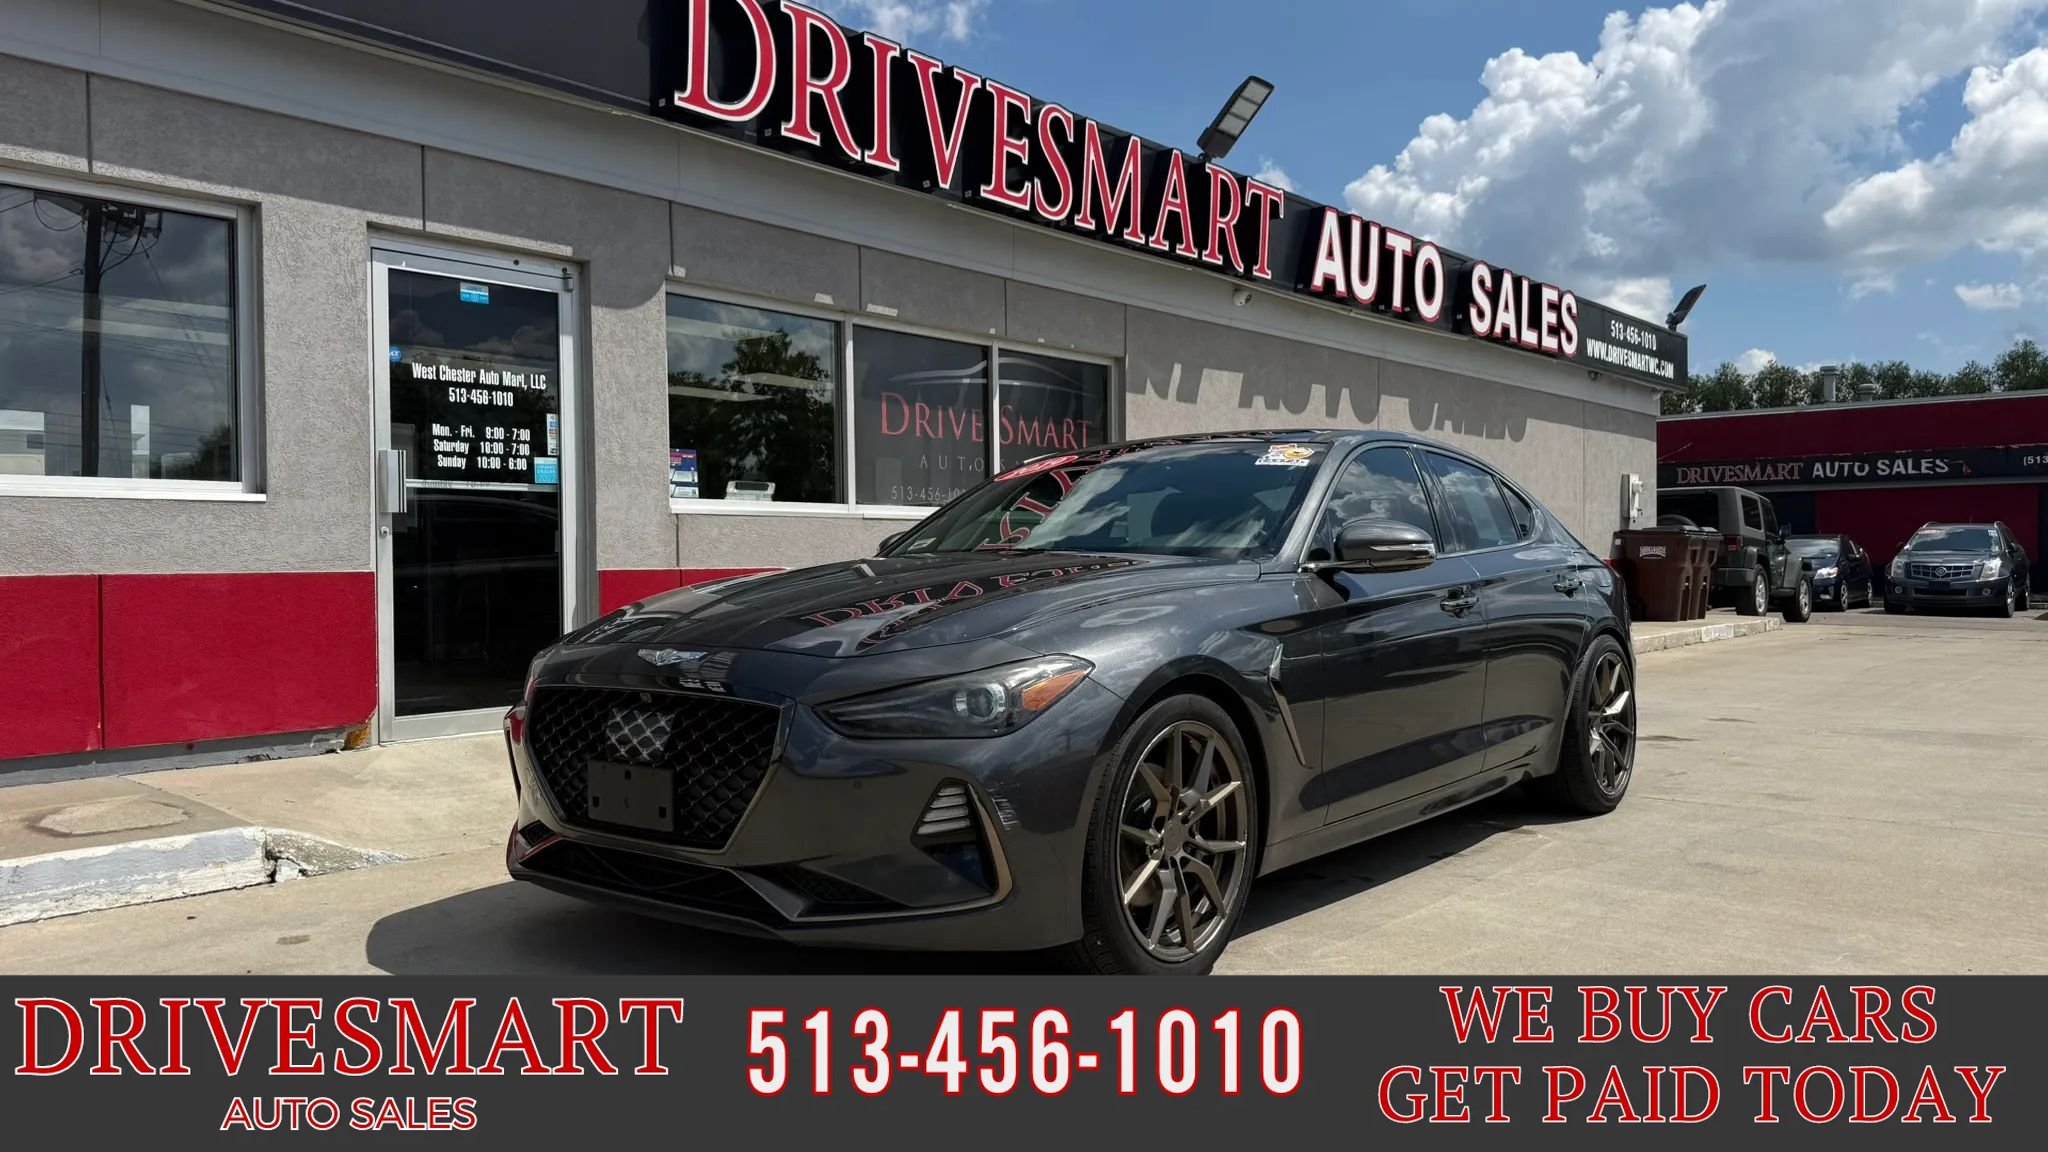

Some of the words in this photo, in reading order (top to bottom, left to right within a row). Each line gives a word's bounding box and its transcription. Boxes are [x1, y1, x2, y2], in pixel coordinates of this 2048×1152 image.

[674, 0, 1284, 279] DRIVESMART
[1311, 206, 1444, 323] AUTO
[1469, 261, 1578, 358] SALES
[1611, 320, 1657, 351] 513-456-1010
[1586, 337, 1674, 379] WWW.DRIVESMARTWC.COM
[412, 362, 437, 380] West
[439, 364, 477, 384] Chester
[480, 368, 500, 386] Auto
[502, 370, 527, 391] Mart,
[530, 373, 547, 390] LLC
[448, 386, 514, 407] 513-456-1010
[432, 423, 453, 437] Mon.
[460, 424, 475, 438] Fri.
[485, 426, 504, 440] 9:00
[511, 428, 530, 441] 7:00
[881, 391, 984, 443] DRIVE
[1000, 404, 1092, 450] SMART
[433, 438, 469, 455] Saturday
[480, 441, 504, 455] 10:00
[511, 443, 530, 456] 7:00
[437, 454, 467, 470] Sunday
[477, 456, 501, 470] 10:00
[508, 457, 527, 471] 6:00
[1676, 461, 1803, 484] DRIVESMART
[1812, 461, 1869, 479] AUTO
[1876, 458, 1949, 476] SALES
